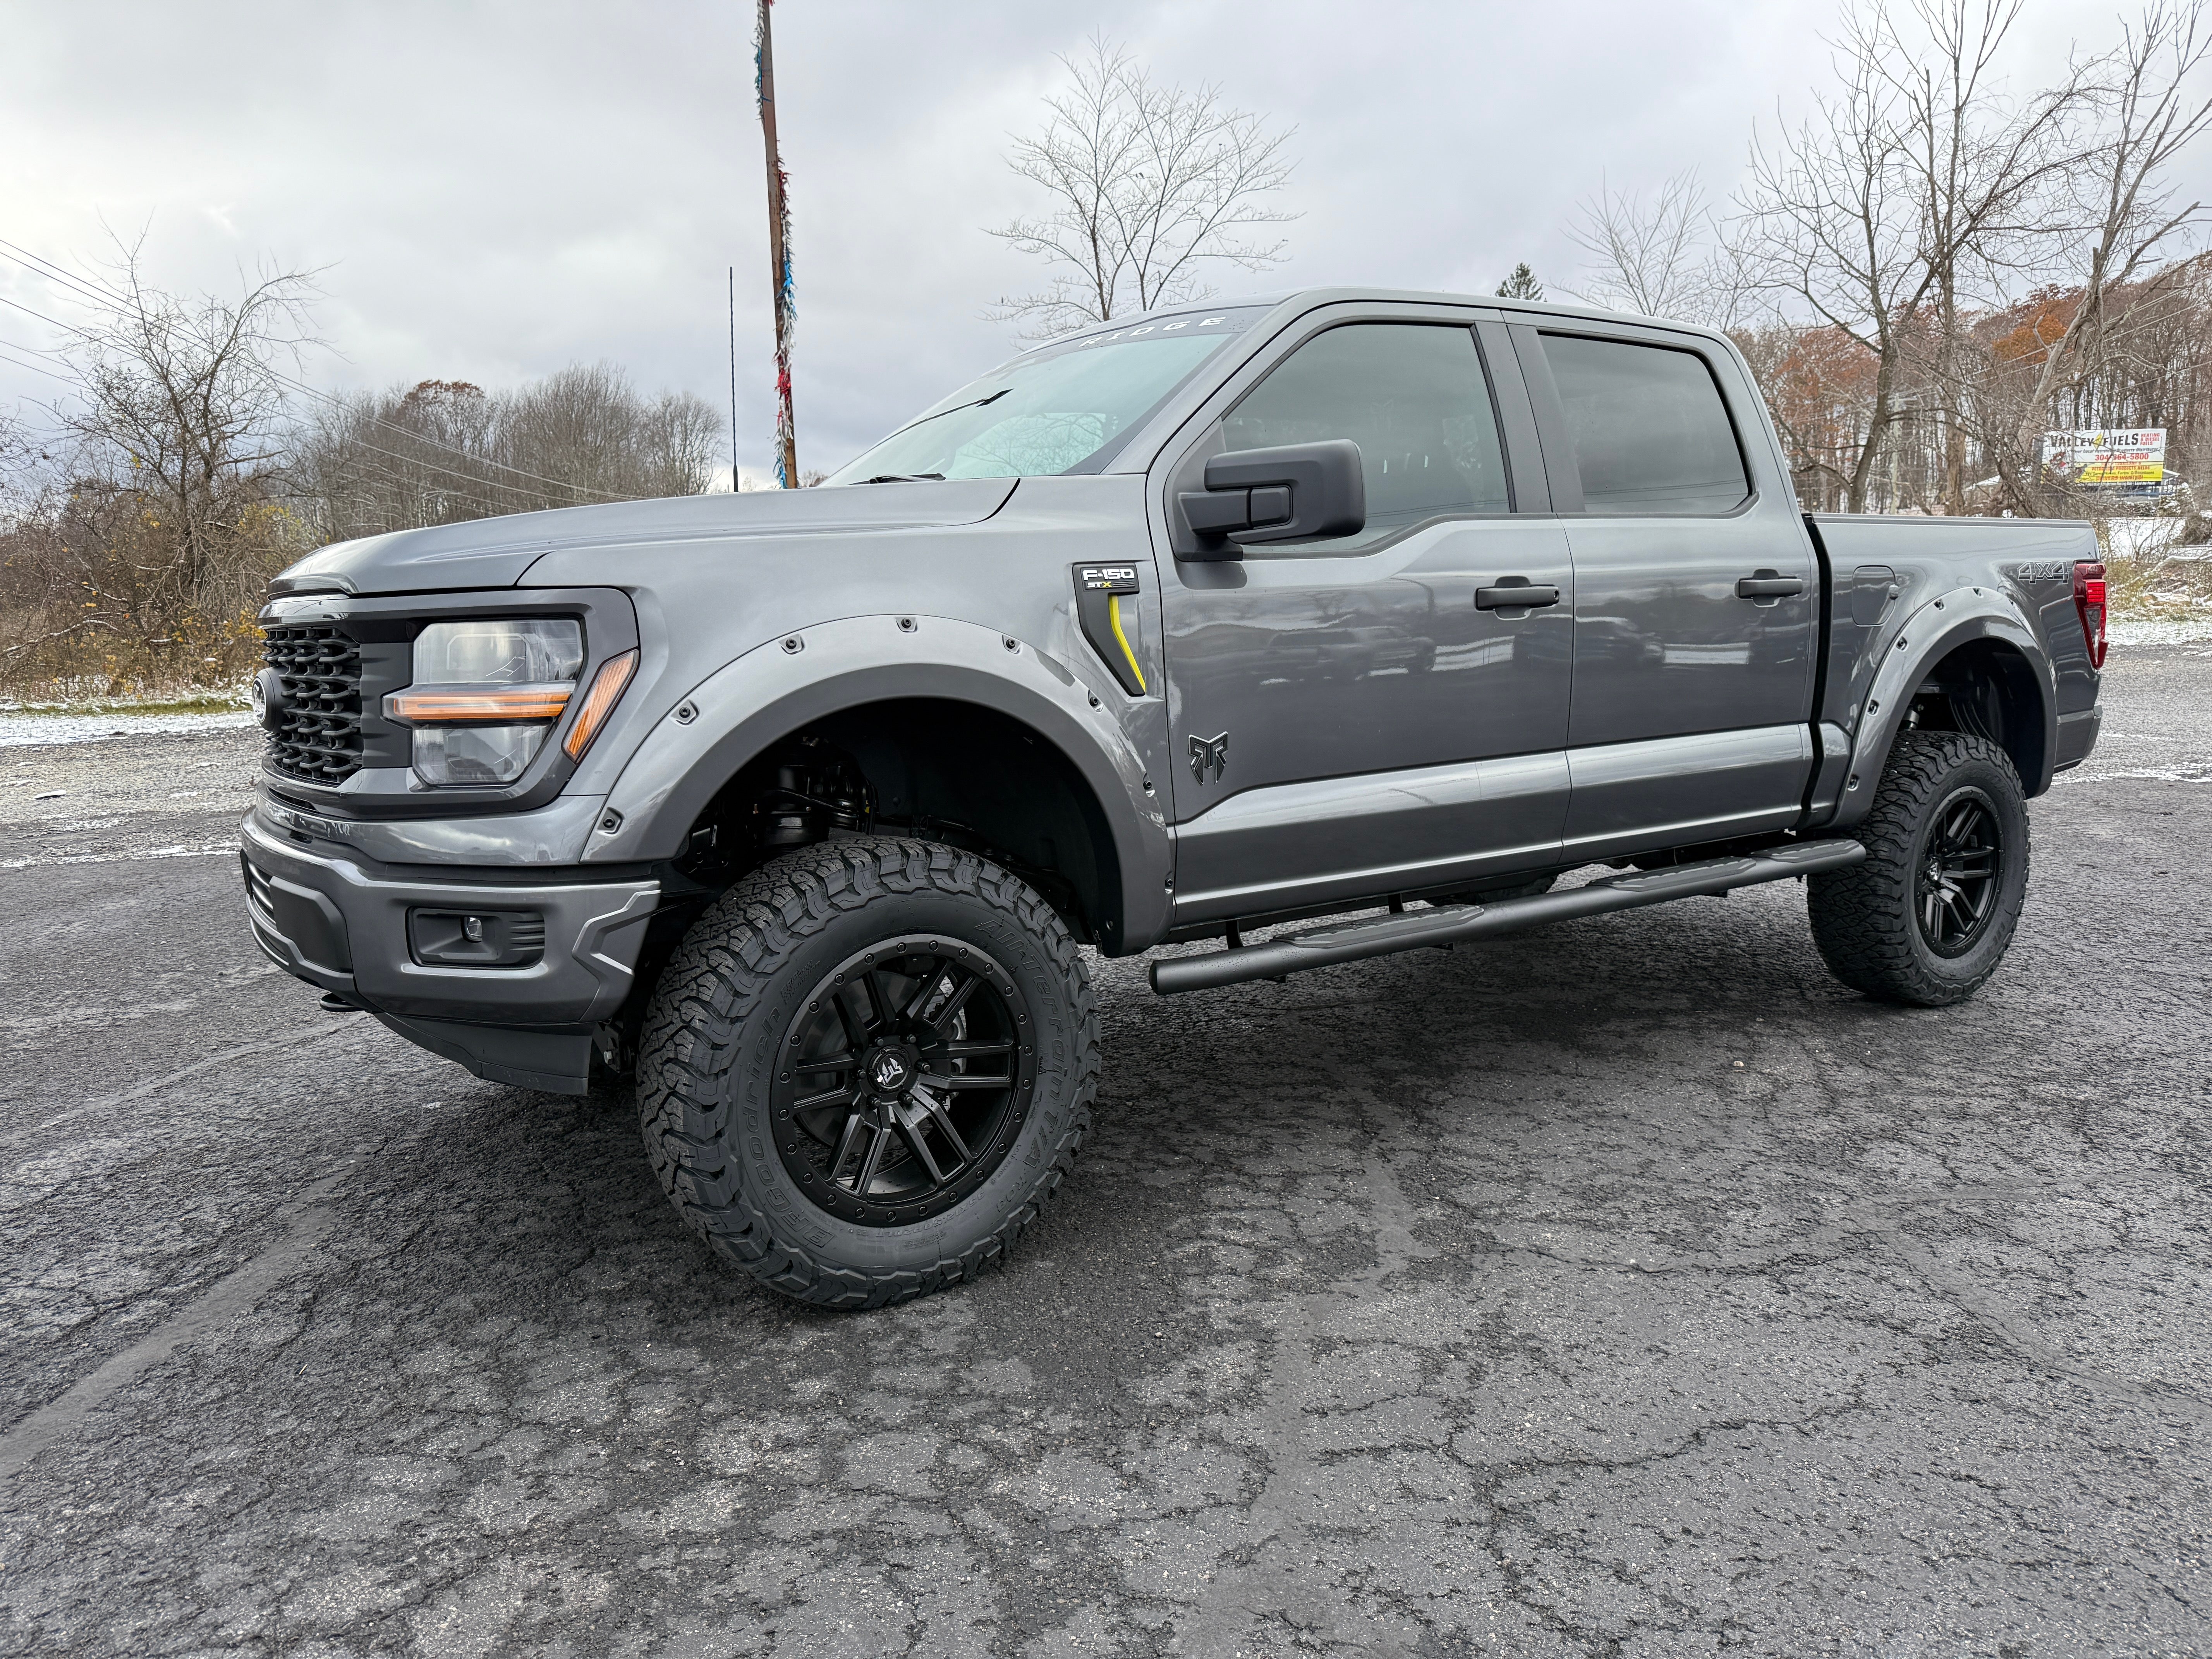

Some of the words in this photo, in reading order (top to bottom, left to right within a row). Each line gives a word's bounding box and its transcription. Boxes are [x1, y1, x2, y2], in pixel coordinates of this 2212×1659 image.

[1079, 317, 1226, 347] RIDGE
[2103, 433, 2139, 446] FUELS
[1082, 568, 1135, 580] F-150
[974, 920, 1065, 1101] All-Terrain
[743, 1007, 836, 1248] BFGoodrich
